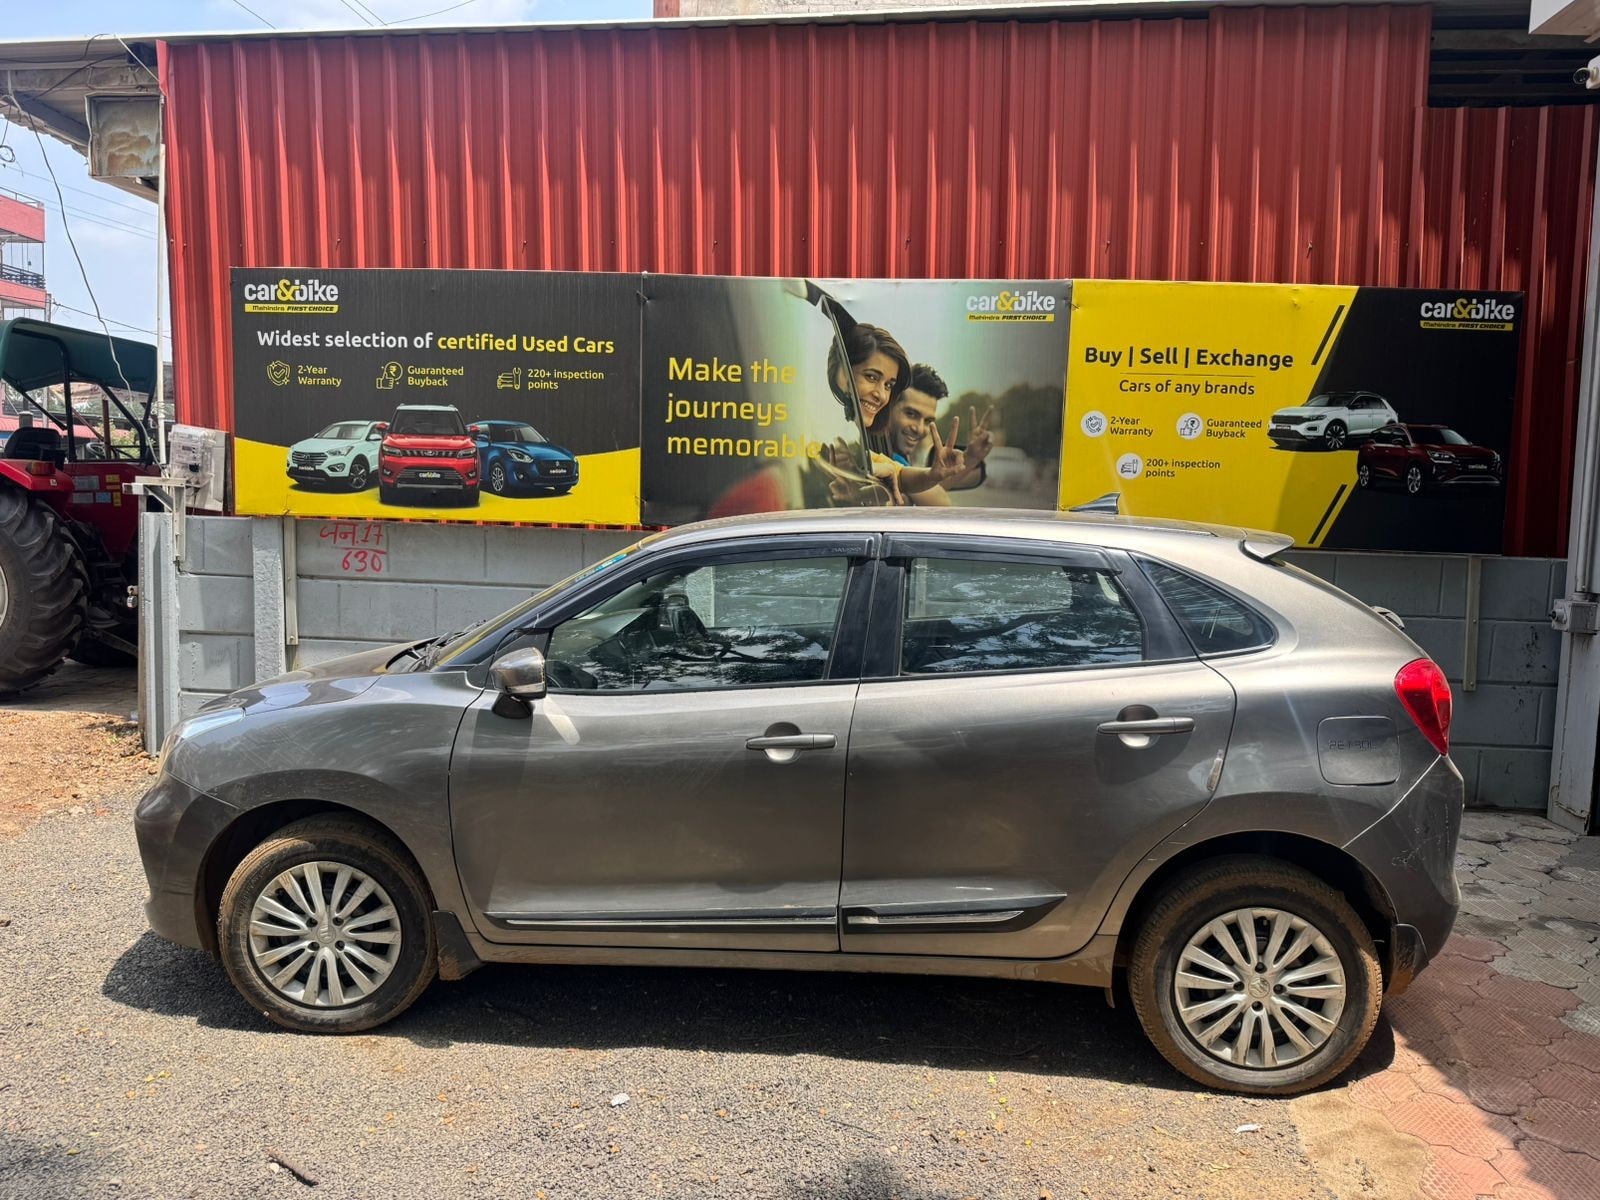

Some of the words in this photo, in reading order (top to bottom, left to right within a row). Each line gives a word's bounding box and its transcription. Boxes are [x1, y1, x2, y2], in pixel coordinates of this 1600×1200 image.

[243, 278, 339, 301] car&bike
[966, 290, 1056, 311] car&bike
[1420, 298, 1515, 320] car&bike
[257, 330, 320, 347] Widest
[325, 331, 408, 348] selection
[413, 332, 434, 348] of
[437, 333, 517, 351] certified
[522, 336, 568, 352] Used
[573, 337, 615, 353] Cars
[1084, 347, 1123, 367] Buy
[1140, 347, 1178, 364] Sell
[1196, 348, 1294, 371] Exchange
[297, 365, 328, 374] 2-Year
[407, 365, 464, 376] Guaranteed
[528, 368, 552, 378] 220+
[553, 368, 605, 380] inspection
[668, 357, 742, 382] Make
[750, 358, 796, 384] the
[297, 376, 342, 387] Warranty
[407, 376, 449, 388] Buyback
[527, 380, 559, 390] points
[1119, 379, 1151, 393] Cars
[1155, 379, 1172, 393] of
[1174, 383, 1201, 396] any
[1205, 381, 1255, 395] brands
[665, 393, 789, 427] journeys
[1110, 416, 1141, 426] 2-Year
[1206, 418, 1262, 428] Guaranteed
[1110, 426, 1154, 437] Warranty
[1206, 429, 1246, 439] Buyback
[667, 433, 822, 460] memorable
[1146, 458, 1169, 468] 200+
[1171, 458, 1221, 470] inspection
[1145, 467, 1176, 478] points
[342, 550, 382, 572] 630
